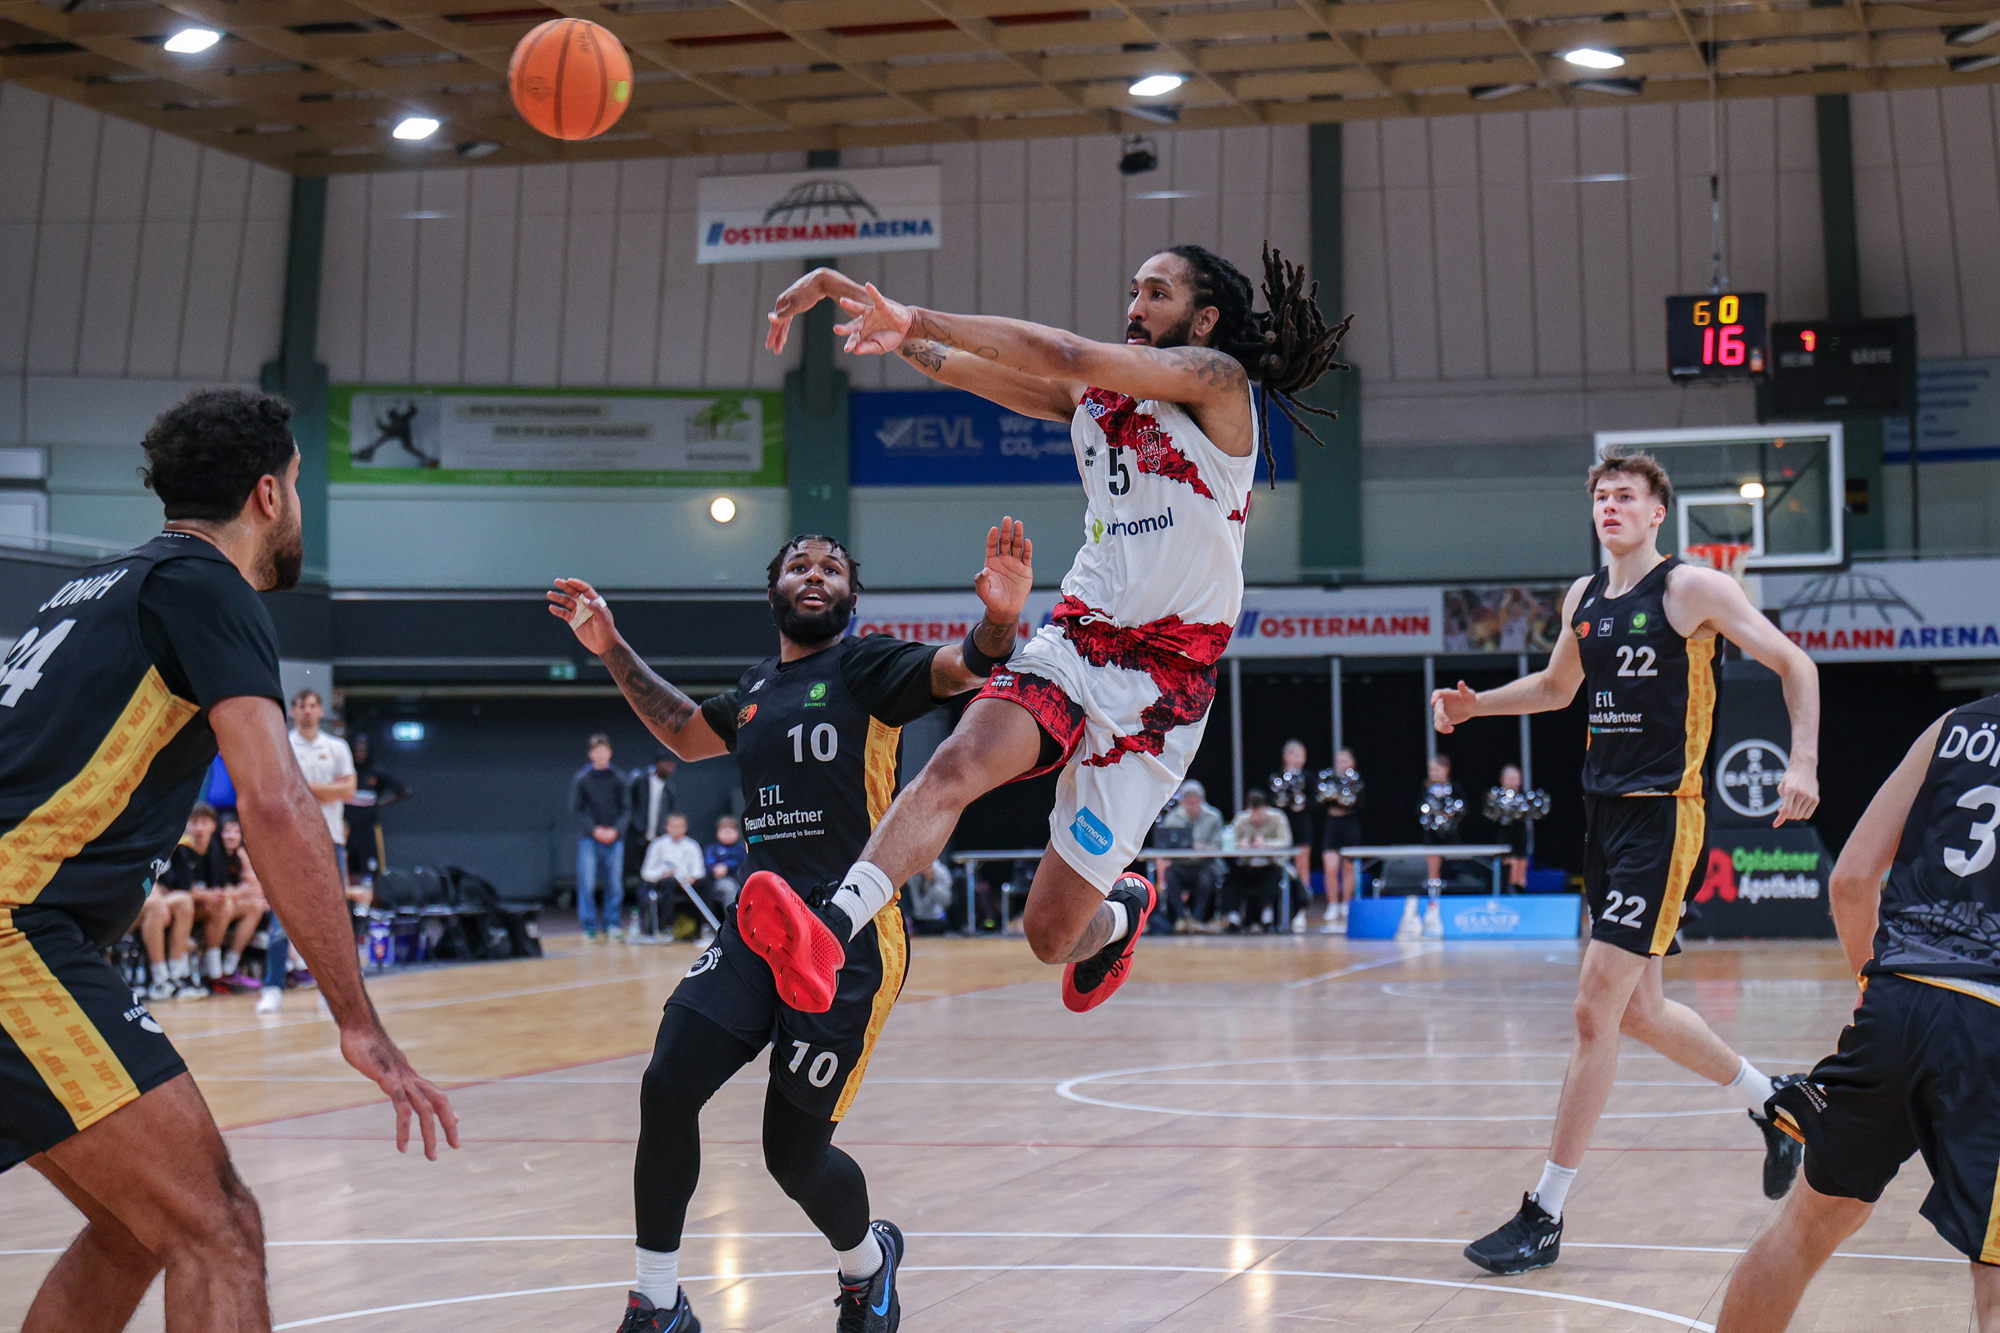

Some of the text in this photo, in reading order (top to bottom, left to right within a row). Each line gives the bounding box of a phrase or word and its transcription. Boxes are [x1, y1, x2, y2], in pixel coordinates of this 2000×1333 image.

[1702, 324, 1746, 366] 16
[1108, 447, 1131, 496] 5
[38, 567, 130, 613] JONAH
[859, 620, 1031, 641] OSTERMN
[1259, 615, 1431, 638] OSTERMANN
[1615, 645, 1658, 677] 22
[787, 722, 838, 763] 10
[1938, 722, 2000, 768] DÖ
[758, 784, 784, 808] ETL
[767, 813, 777, 827] &
[776, 809, 823, 826] Partner
[1077, 815, 1109, 847] Barmenia
[1943, 784, 2000, 878] 3
[1601, 889, 1647, 929] 22
[788, 1039, 839, 1088] 10
